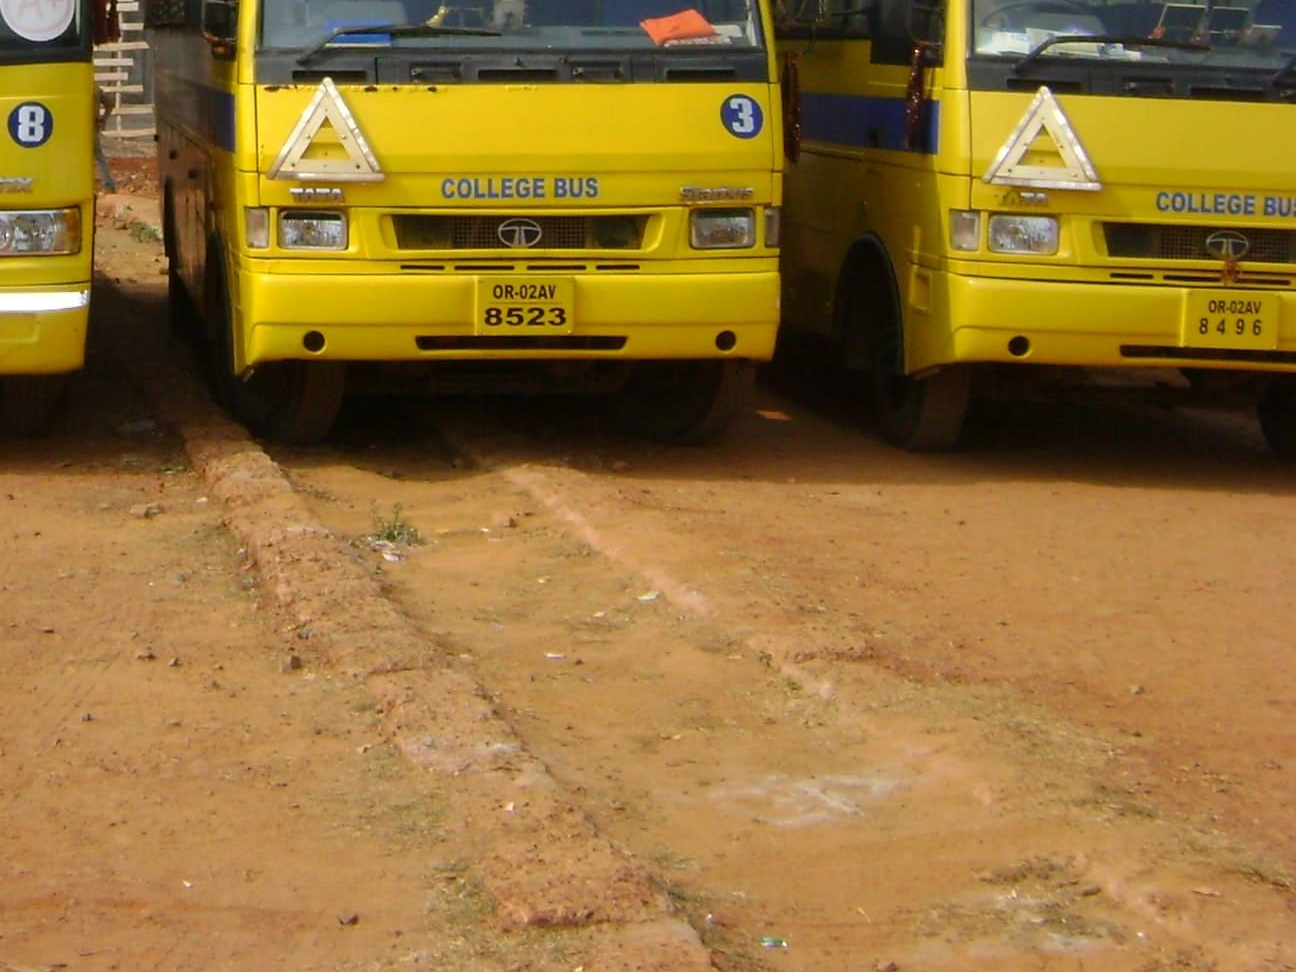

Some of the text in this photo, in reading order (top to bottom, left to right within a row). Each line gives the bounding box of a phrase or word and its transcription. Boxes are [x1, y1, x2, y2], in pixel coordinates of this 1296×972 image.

[17, 105, 45, 142] 8
[729, 97, 755, 133] 3
[441, 177, 599, 199] COLLEGE BUS
[1156, 190, 1256, 215] COLLEGE
[492, 284, 556, 299] OR-02AV
[484, 307, 566, 326] 8523
[1208, 299, 1261, 315] OR-02AV
